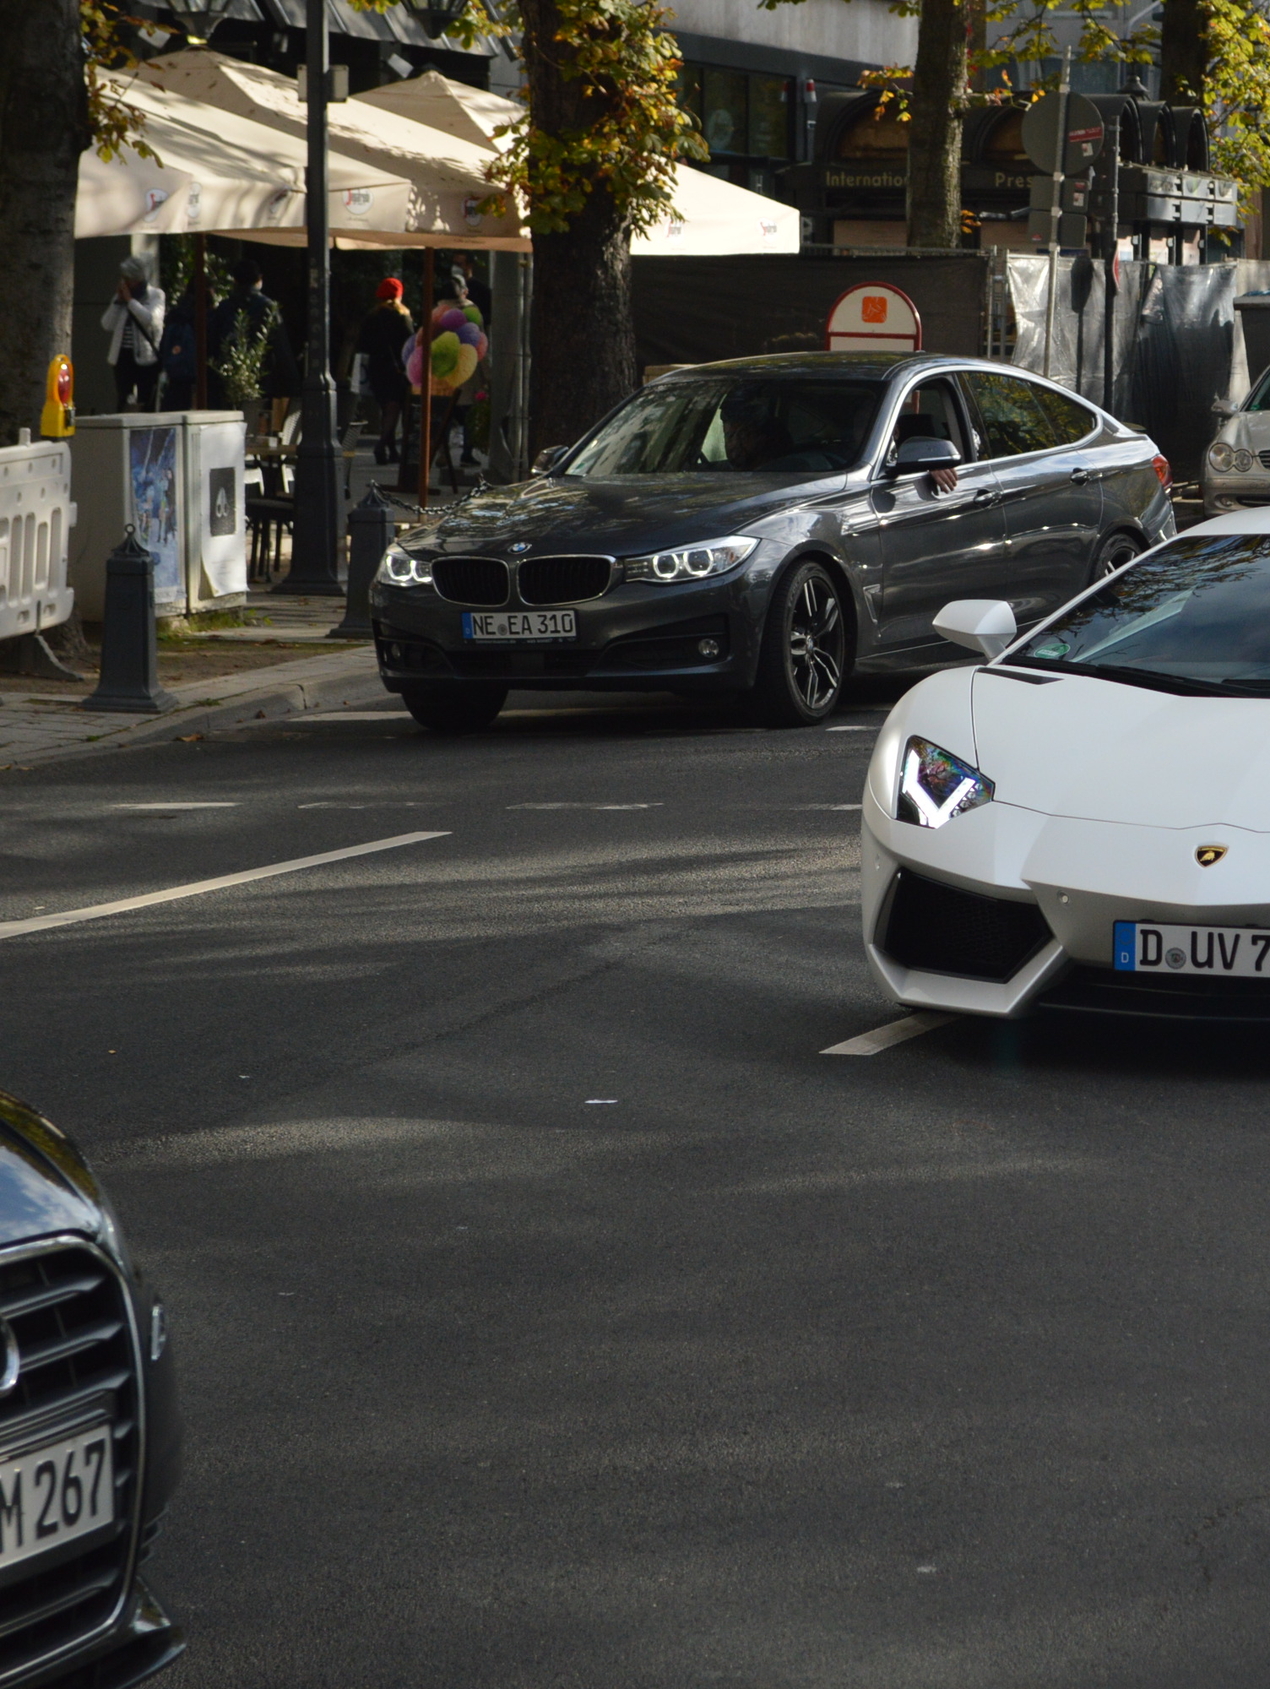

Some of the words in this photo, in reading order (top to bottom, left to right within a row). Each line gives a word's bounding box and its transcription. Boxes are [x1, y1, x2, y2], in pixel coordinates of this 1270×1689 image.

[472, 615, 496, 636] NE
[507, 614, 533, 635] EA
[537, 613, 573, 634] 310
[1139, 929, 1163, 967] D
[1190, 931, 1241, 971] UV
[34, 1437, 106, 1540] 267
